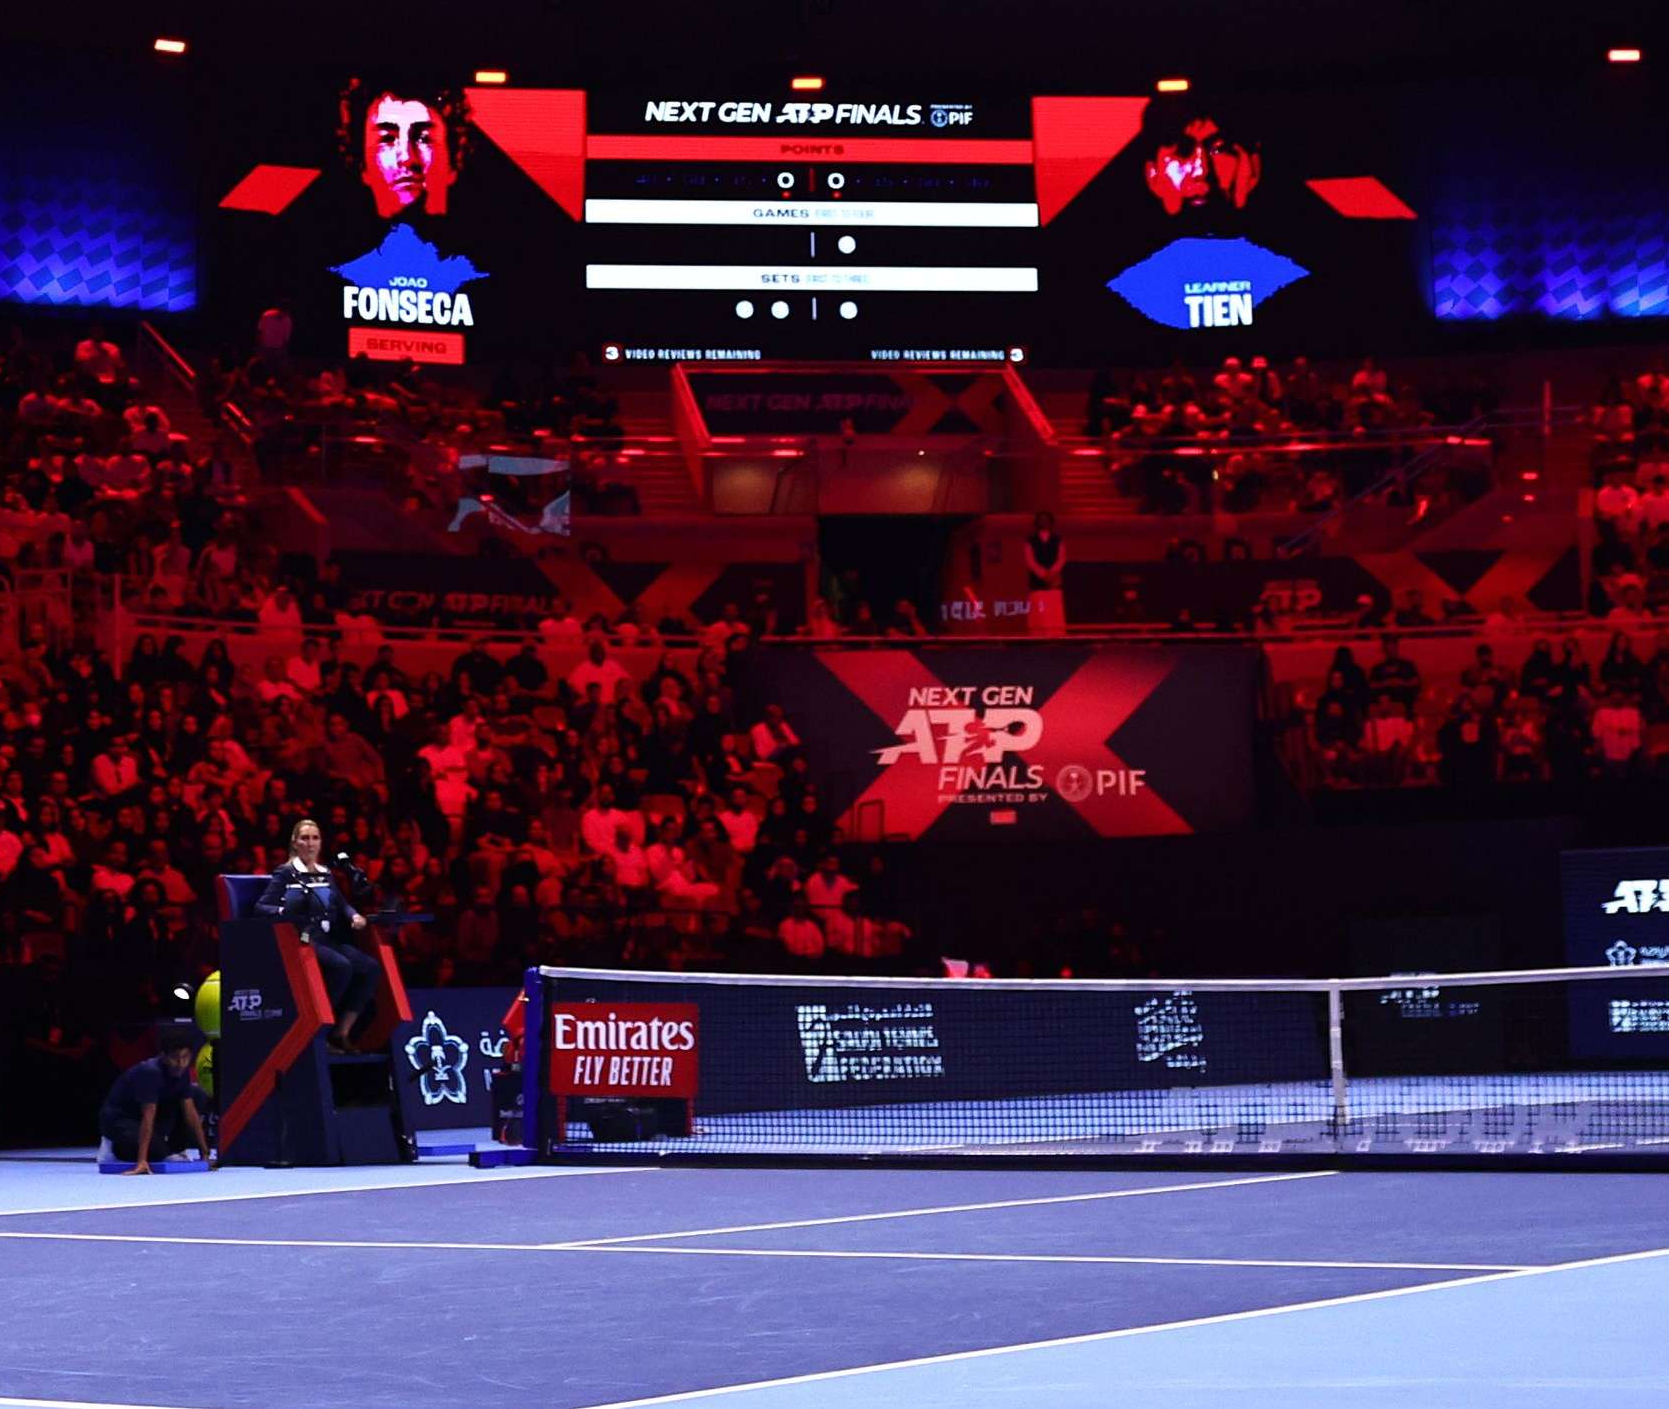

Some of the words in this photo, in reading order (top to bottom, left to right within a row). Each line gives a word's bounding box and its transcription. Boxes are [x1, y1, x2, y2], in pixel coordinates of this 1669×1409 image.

[645, 101, 716, 122] NEXT
[718, 102, 772, 123] GEN
[776, 103, 834, 124] ATP
[835, 104, 922, 125] FINALS
[949, 111, 974, 126] PIF
[781, 144, 845, 155] POINTS
[753, 208, 810, 219] GAMES
[761, 274, 800, 284] SETS
[1184, 281, 1251, 293] LEARNER
[343, 286, 474, 326] FONSECA
[1184, 293, 1253, 328] TIEN
[365, 337, 447, 355] SERVING
[625, 349, 655, 359] VIDEO
[658, 349, 702, 359] REVIEWS
[705, 349, 761, 360] REMAINING
[871, 350, 900, 360] VIDEO
[903, 350, 947, 360] REVIEWS
[950, 350, 1005, 360] REMAINING
[908, 687, 977, 706] NEXT
[982, 687, 1034, 706] GEN
[870, 708, 1044, 765] ATP
[938, 765, 1044, 790] FINALS
[1097, 770, 1147, 795] PIF
[938, 793, 1025, 804] PRESENTED
[1029, 793, 1048, 803] BY
[554, 1012, 695, 1052] Emirates
[573, 1056, 605, 1086] FLY
[608, 1055, 673, 1087] BETTER
